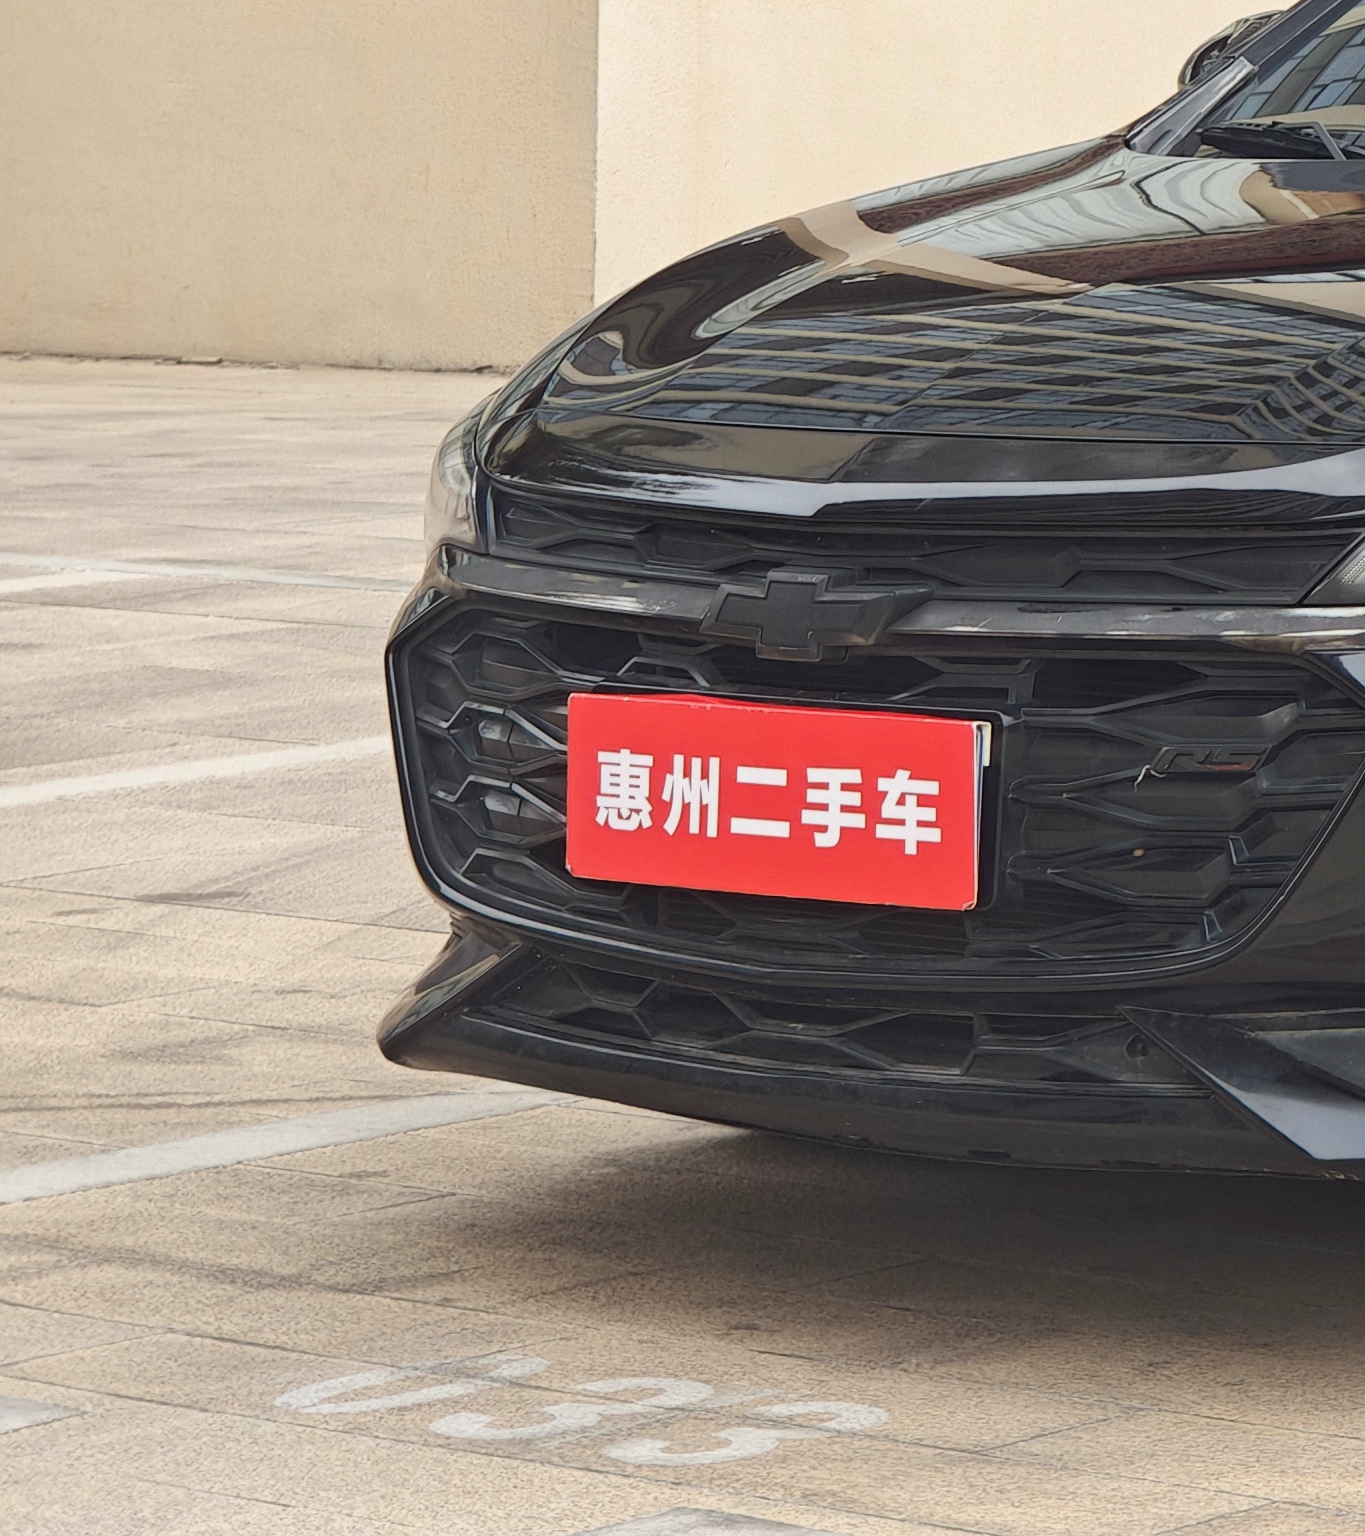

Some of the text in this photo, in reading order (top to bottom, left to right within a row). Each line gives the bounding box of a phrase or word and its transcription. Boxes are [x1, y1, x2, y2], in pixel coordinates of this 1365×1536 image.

[595, 748, 942, 855] 惠州二手车
[1151, 745, 1270, 773] RS
[274, 1353, 890, 1467] 033
